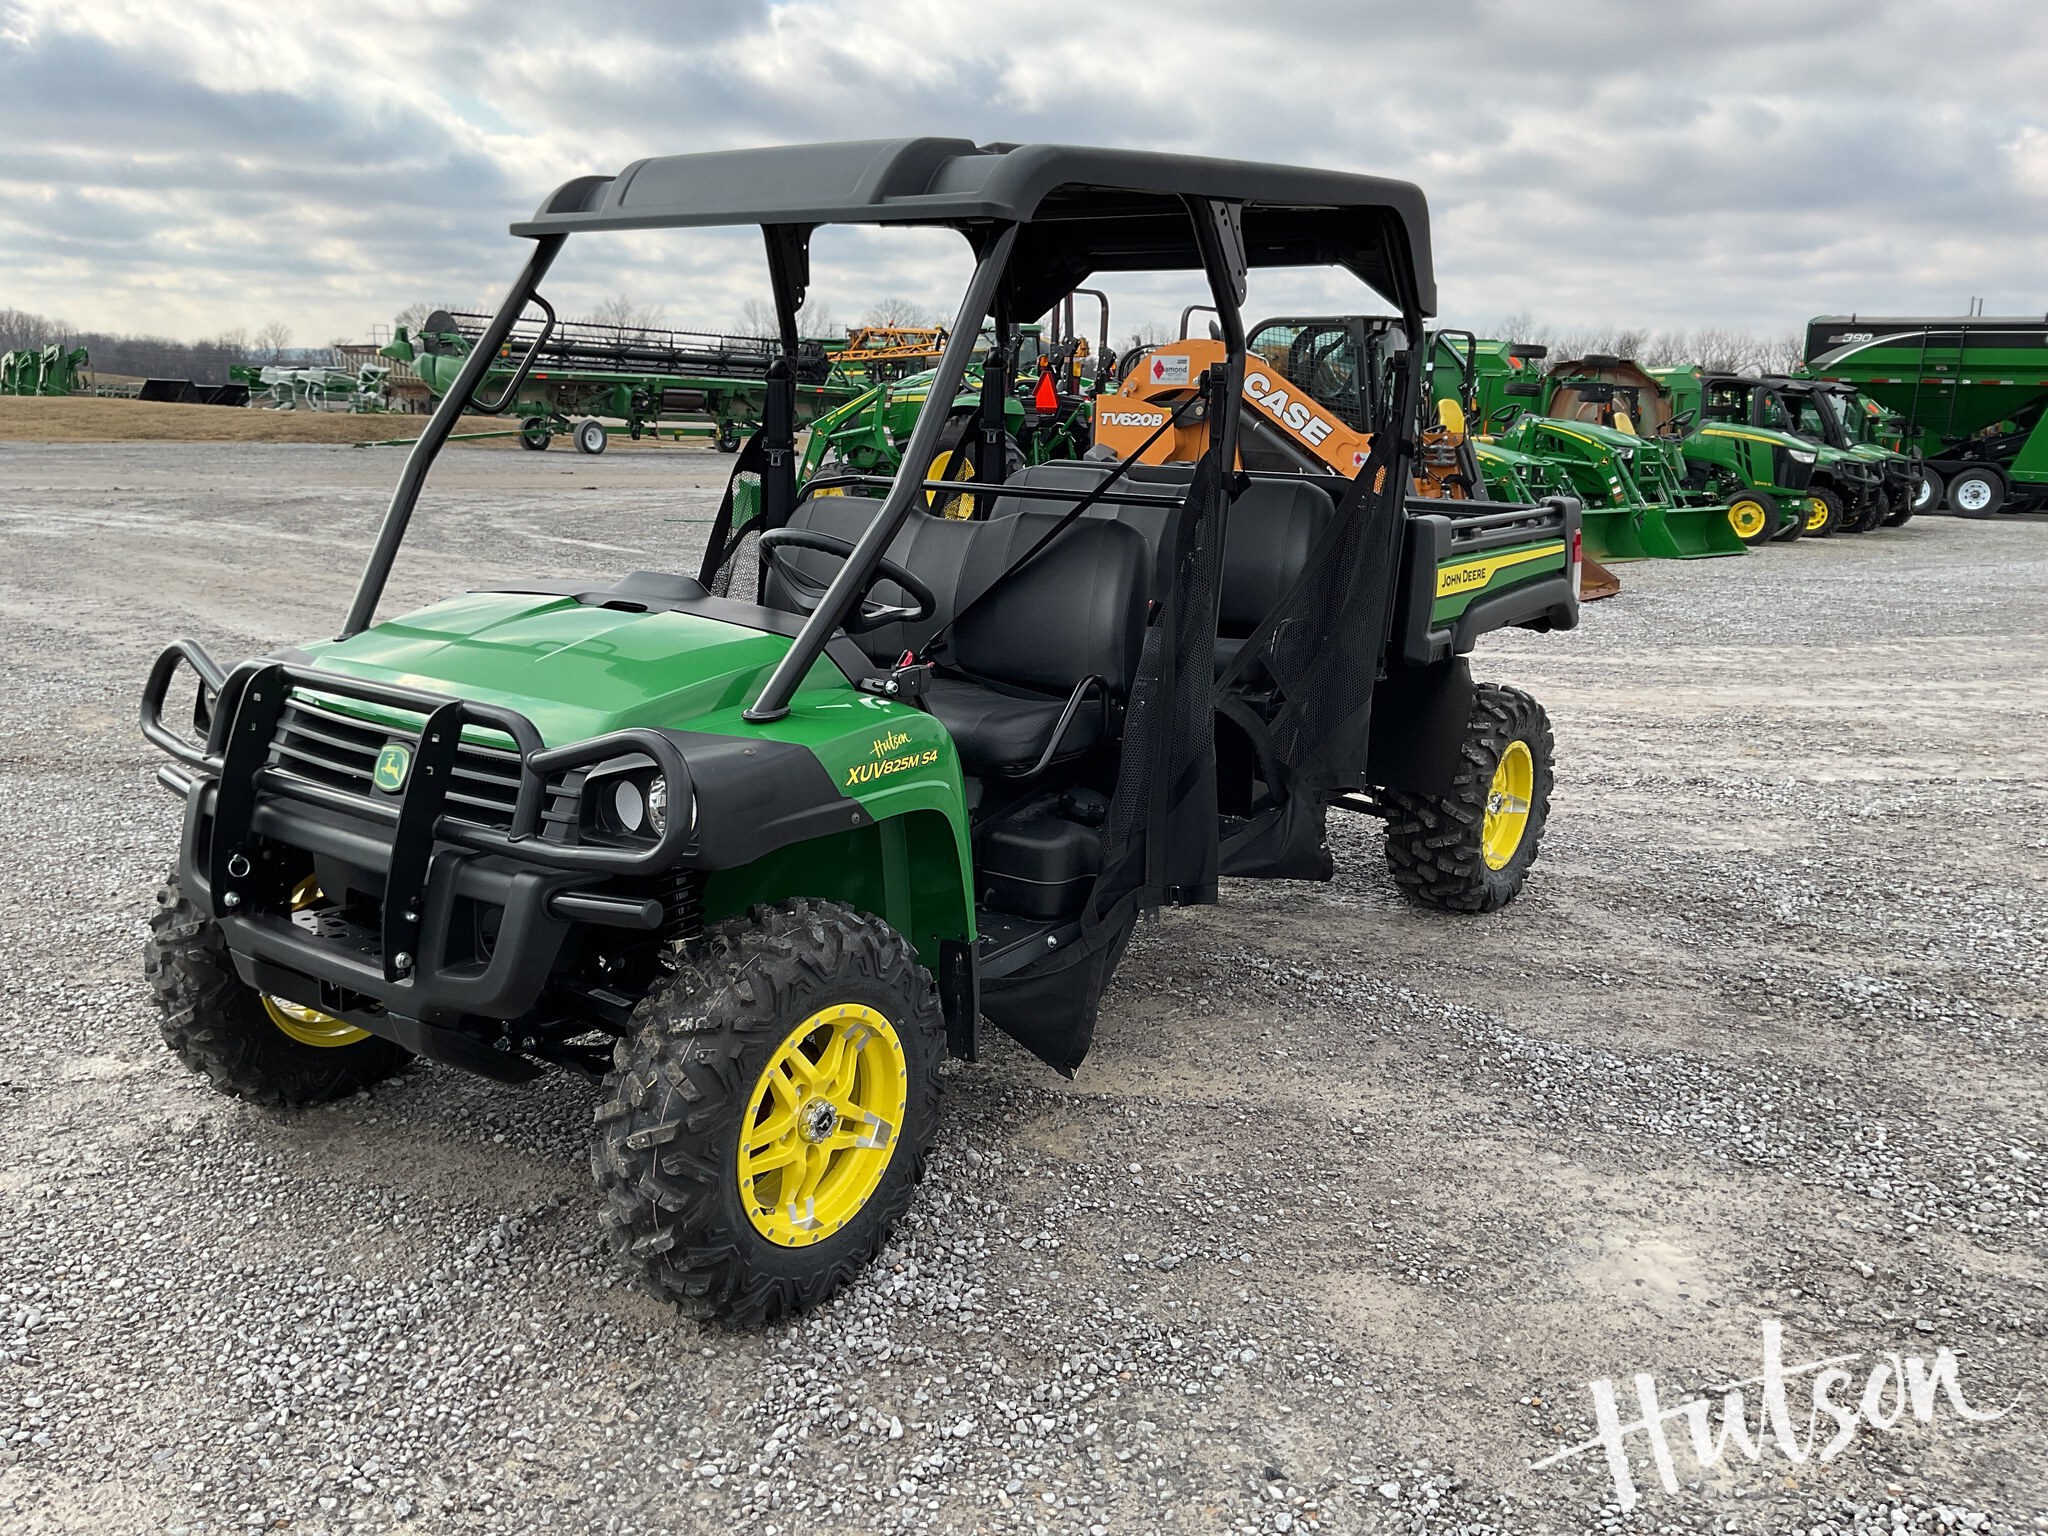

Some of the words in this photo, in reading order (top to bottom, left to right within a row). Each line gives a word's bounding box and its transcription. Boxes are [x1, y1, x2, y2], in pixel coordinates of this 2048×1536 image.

[1101, 412, 1163, 427] TV620B
[1243, 372, 1335, 448] CASE
[1441, 573, 1462, 588] JOHN
[1462, 567, 1487, 583] DEERE
[869, 731, 913, 759] Hutson
[845, 753, 920, 787] XUV825M
[921, 749, 939, 766] S4
